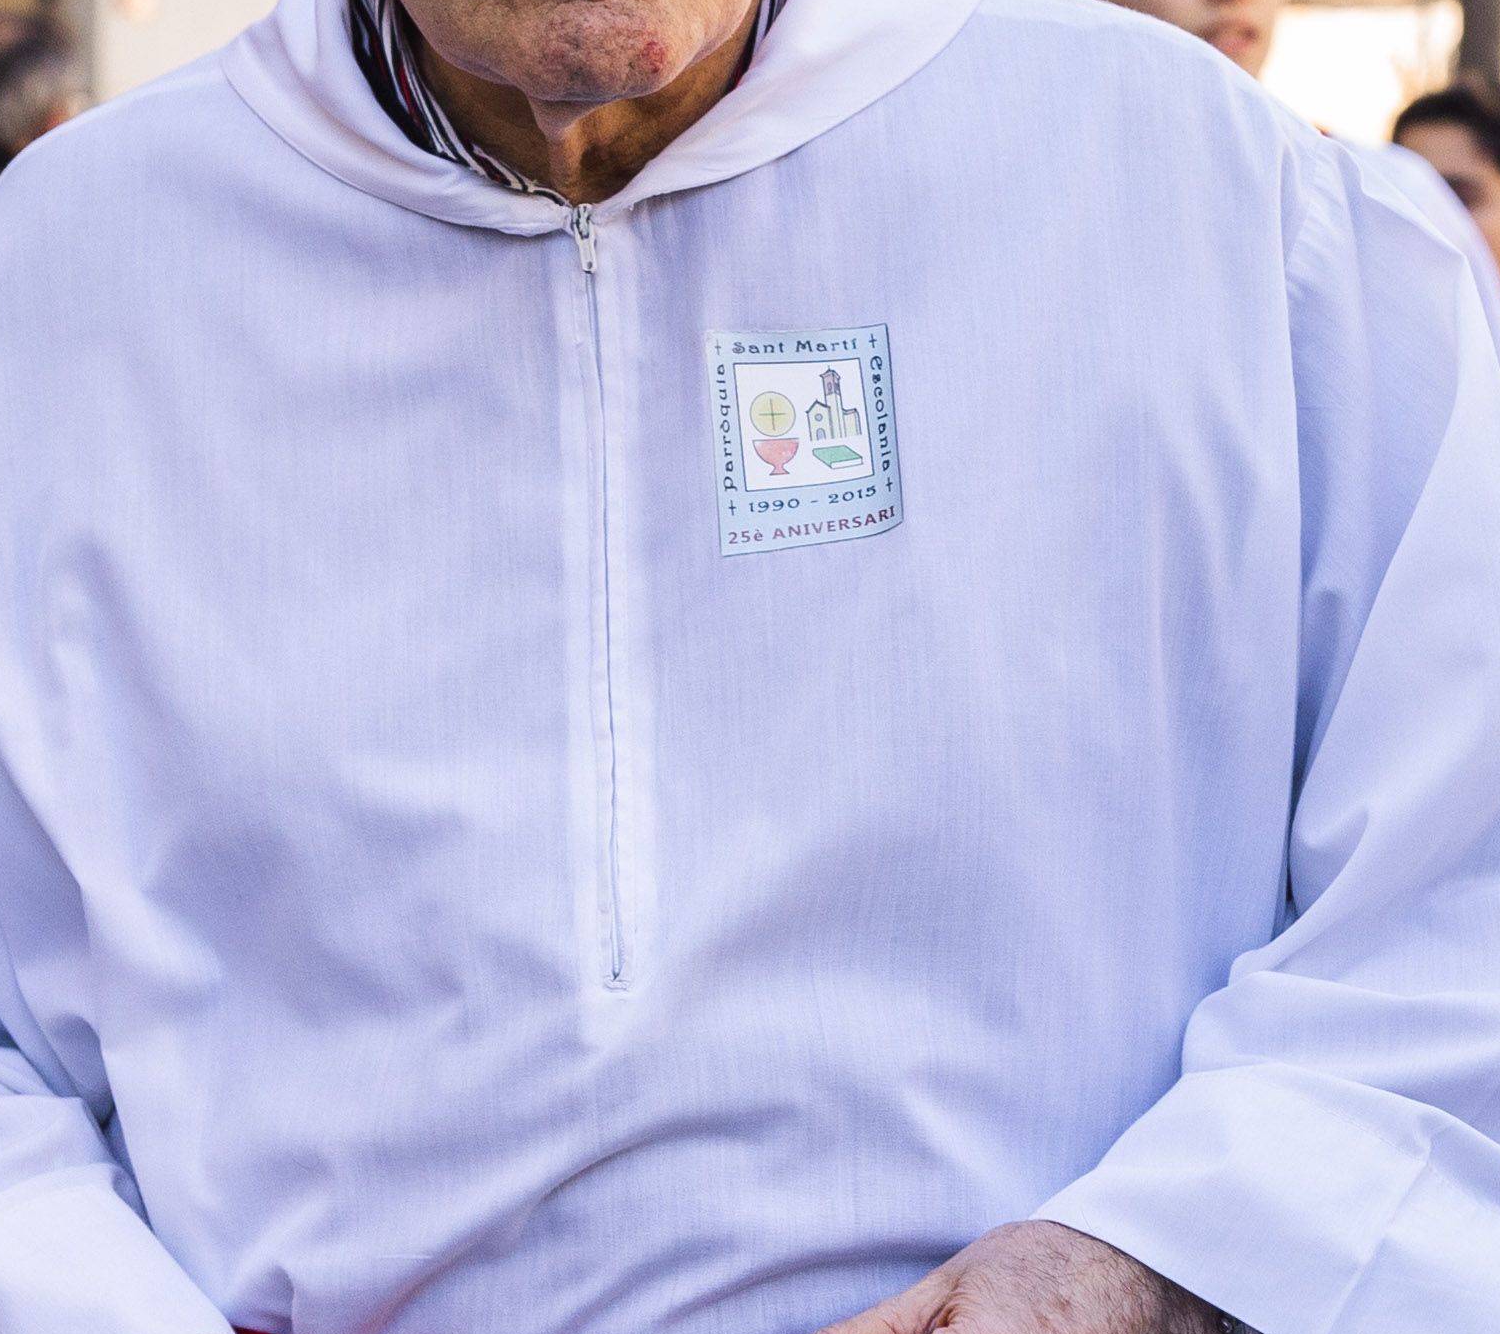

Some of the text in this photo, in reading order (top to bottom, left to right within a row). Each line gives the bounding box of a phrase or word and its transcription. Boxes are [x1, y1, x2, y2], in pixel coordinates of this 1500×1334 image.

[732, 338, 858, 355] Sant Martí
[715, 364, 738, 492] Parròquia
[869, 354, 891, 473] Escolania
[749, 498, 800, 513] 1990
[828, 485, 877, 505] 2015
[728, 505, 896, 545] 25è ANIVERSARI
